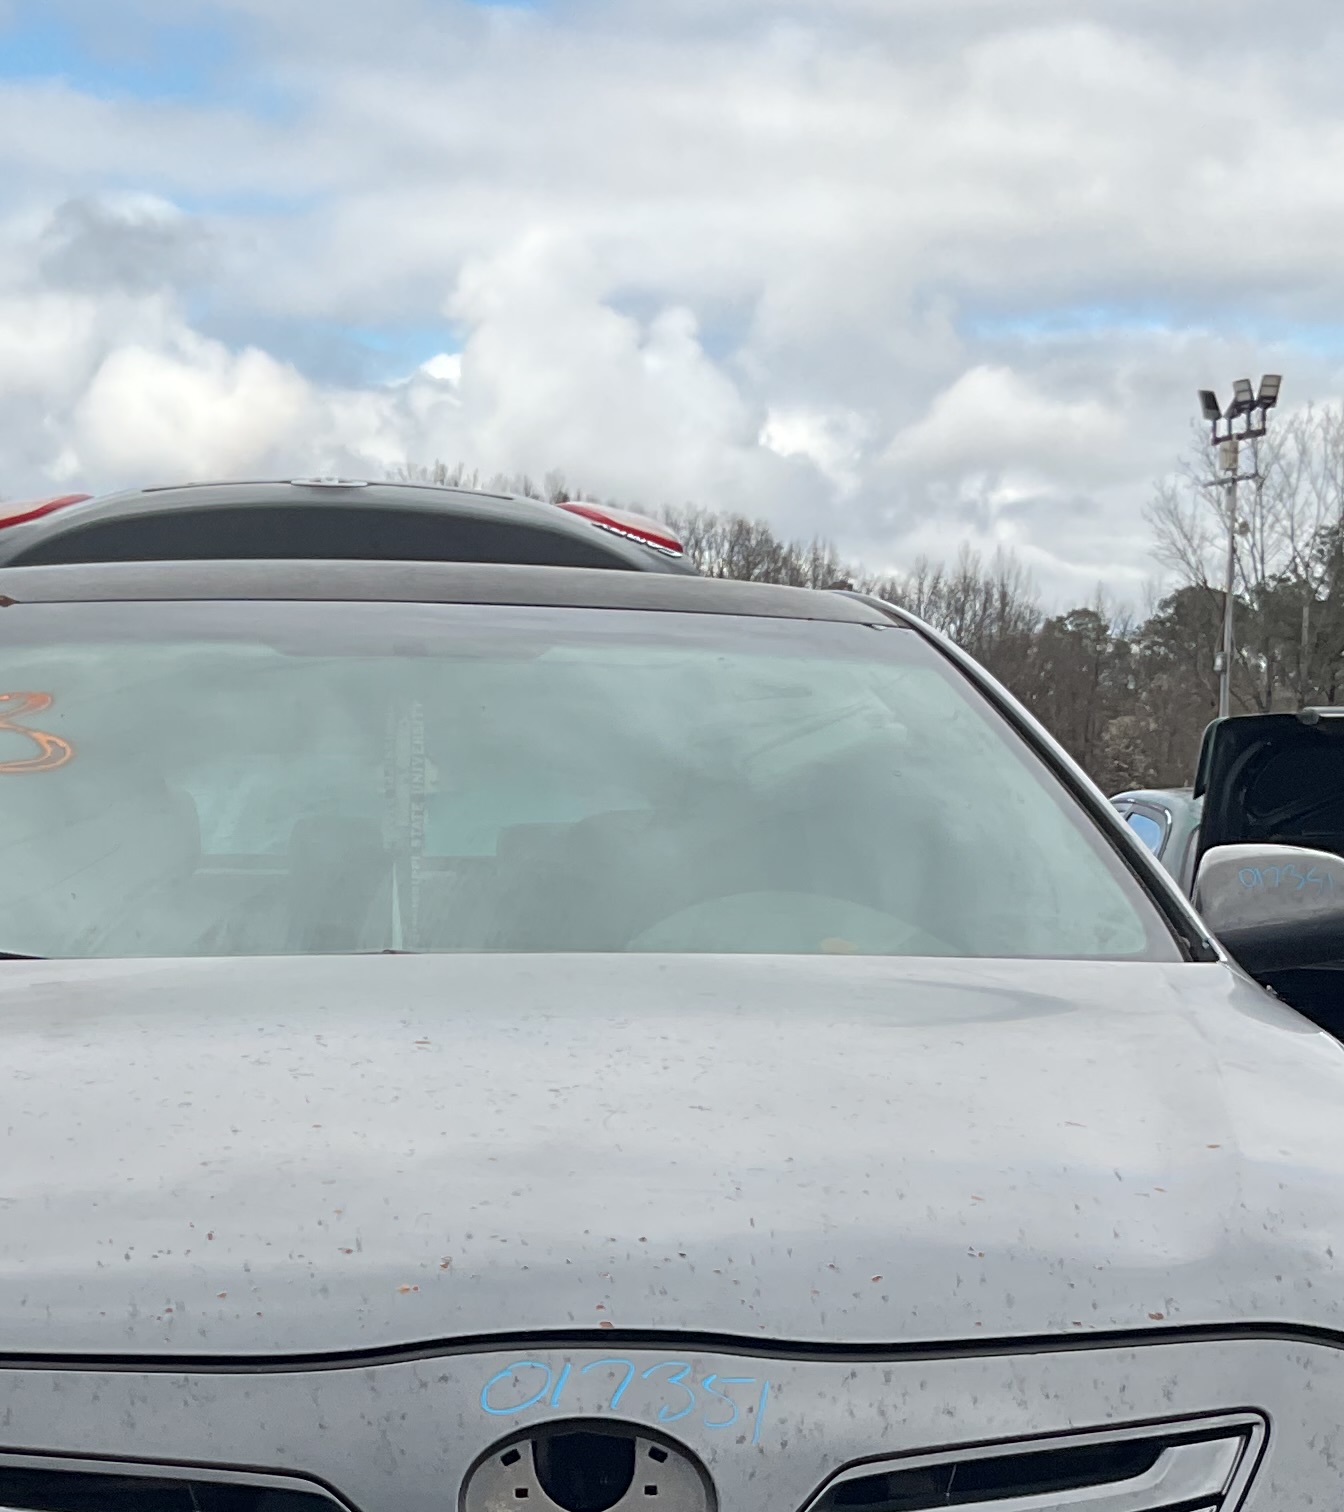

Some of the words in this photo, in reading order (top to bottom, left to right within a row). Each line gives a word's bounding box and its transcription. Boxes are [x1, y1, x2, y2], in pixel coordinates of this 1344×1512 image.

[410, 801, 424, 848] STATE
[1238, 863, 1334, 897] 017351
[480, 1358, 770, 1445] 017351
